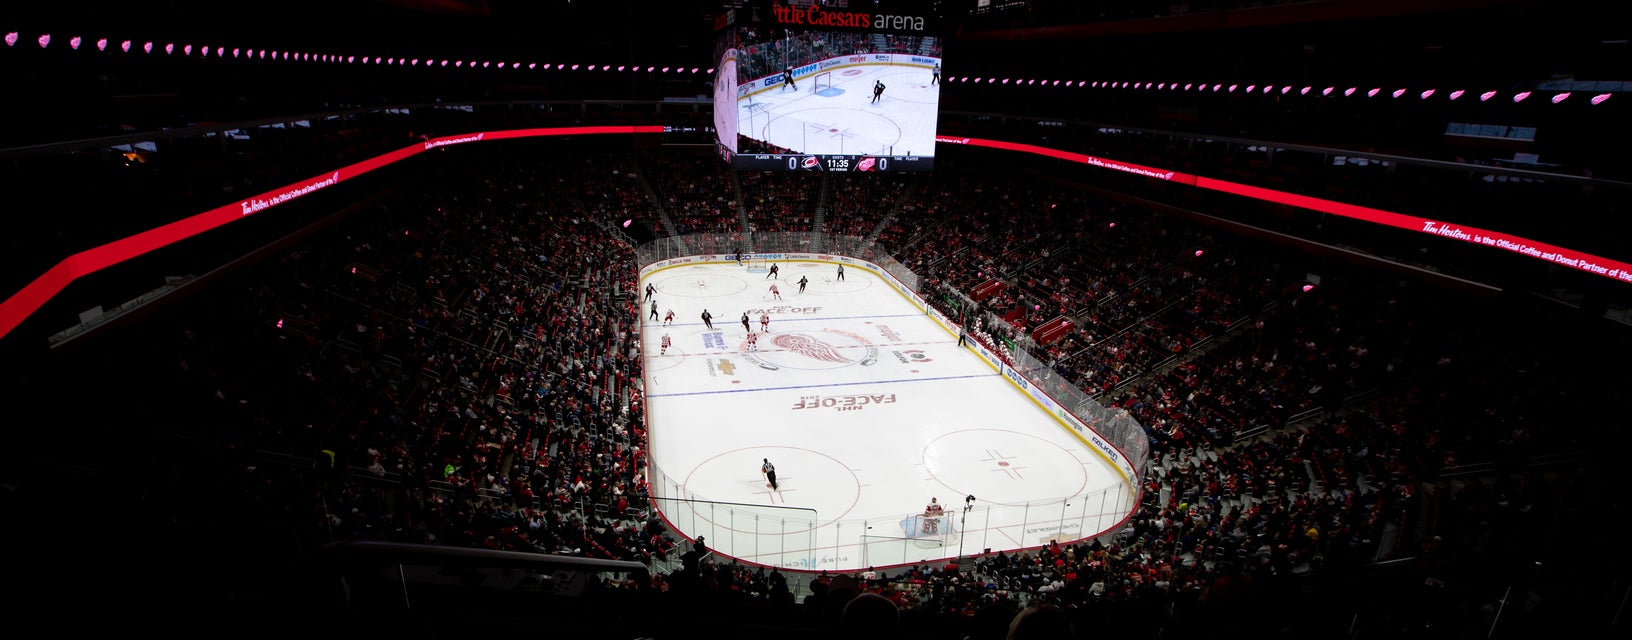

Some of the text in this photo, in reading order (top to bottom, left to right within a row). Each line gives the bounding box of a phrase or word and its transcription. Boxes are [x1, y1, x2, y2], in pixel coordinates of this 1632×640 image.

[807, 4, 870, 28] Caesars
[874, 14, 924, 31] arena
[788, 157, 797, 169] 0
[880, 158, 887, 170] 0
[1423, 222, 1438, 233] Tim
[1438, 224, 1471, 240] Hortons
[1483, 237, 1496, 245] the
[1496, 239, 1520, 251] Official
[1520, 245, 1541, 257] Coffee
[1555, 254, 1578, 266] Donut
[1578, 260, 1608, 274] Partner
[1608, 268, 1619, 277] of
[1619, 270, 1632, 281] the
[792, 394, 896, 410] FACE-OFF
[1092, 437, 1118, 460] FALKEN
